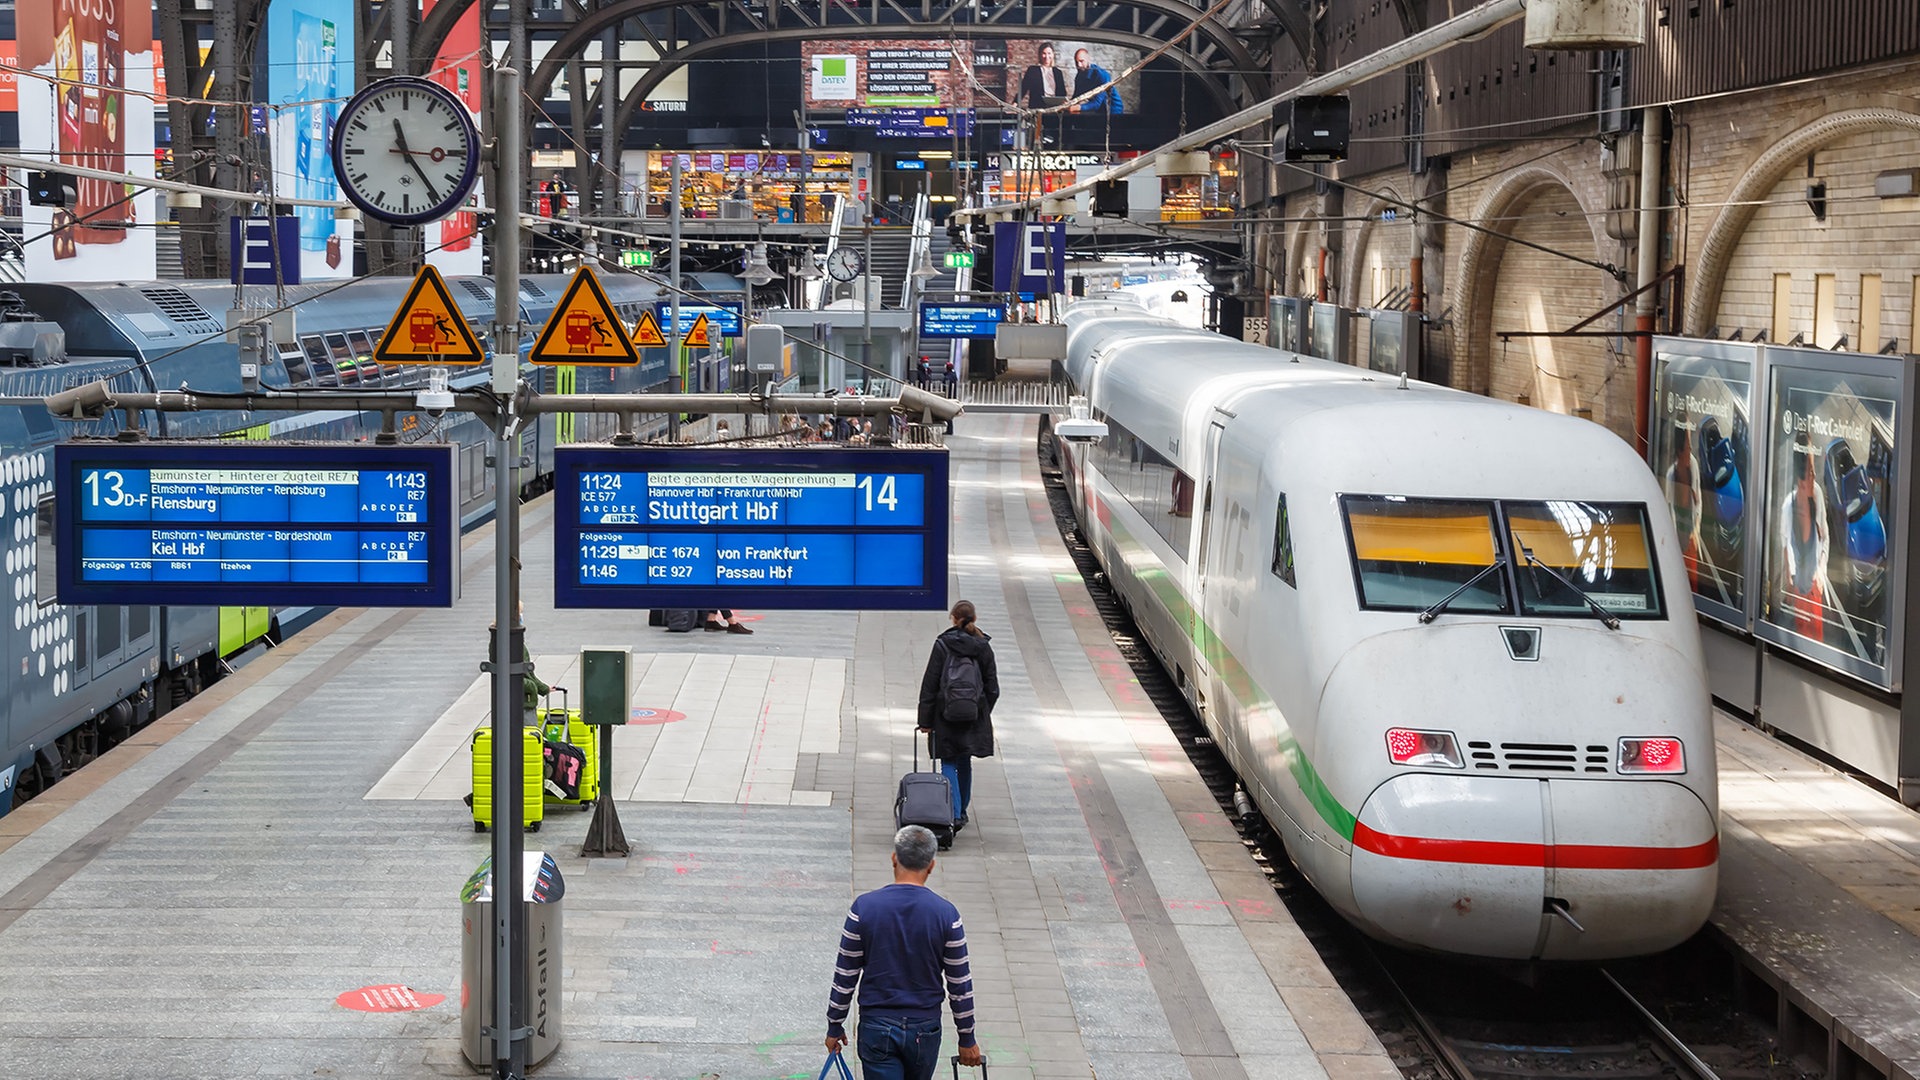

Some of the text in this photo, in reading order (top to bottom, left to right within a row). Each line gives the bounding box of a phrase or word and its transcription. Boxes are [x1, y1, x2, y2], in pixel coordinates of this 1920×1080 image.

[653, 101, 687, 112] SATURN
[987, 157, 999, 171] 14
[73, 145, 115, 207] MIX
[240, 219, 271, 269] E
[1024, 225, 1056, 276] E
[662, 307, 672, 317] 13
[987, 309, 997, 318] 14
[1245, 319, 1268, 331] 355
[1253, 332, 1261, 343] 2
[1793, 411, 1807, 432] Das
[1807, 413, 1828, 436] T-Roc
[1828, 417, 1864, 442] Cabriolet
[230, 471, 280, 482] Hinterer
[283, 471, 323, 483] Zugteil
[327, 472, 348, 482] RE7
[386, 473, 426, 489] 11:43
[582, 474, 622, 490] 11:24
[649, 474, 681, 485] eigte
[751, 475, 836, 487] Wagenreihung
[84, 471, 148, 507] 13 D-F
[151, 484, 196, 495] Elmshorn
[206, 484, 264, 495] Neumünster
[274, 485, 326, 498] Rendsburg
[407, 490, 426, 500] RE7
[649, 488, 694, 498] Hannover
[697, 488, 714, 498] Hbf
[723, 488, 803, 499] Frankfurt(M)Hbf
[857, 475, 899, 512] 14
[581, 492, 616, 502] ICE 577
[151, 496, 216, 513] Flensburg
[361, 504, 414, 512] A B C D E F
[583, 505, 636, 513] A B C D E F
[648, 500, 779, 524] Stuttgart Hbf
[152, 530, 197, 541] Elmshorn
[206, 530, 264, 541] Neumünster
[275, 531, 332, 542] Bordesholm
[407, 531, 426, 542] RE7
[580, 532, 623, 542] Folgezüge
[152, 543, 206, 555] Kiel Hbf
[361, 542, 414, 550] A B C D E F
[581, 545, 618, 559] 11:29
[648, 547, 667, 559] ICE
[671, 546, 700, 559] 1674
[716, 549, 741, 560] von
[745, 547, 808, 560] Frankfurt
[82, 561, 126, 571] Folgezüge
[581, 564, 793, 579] 11:46 ICE 927 Passau Hbf
[537, 947, 547, 1038] Abfall
